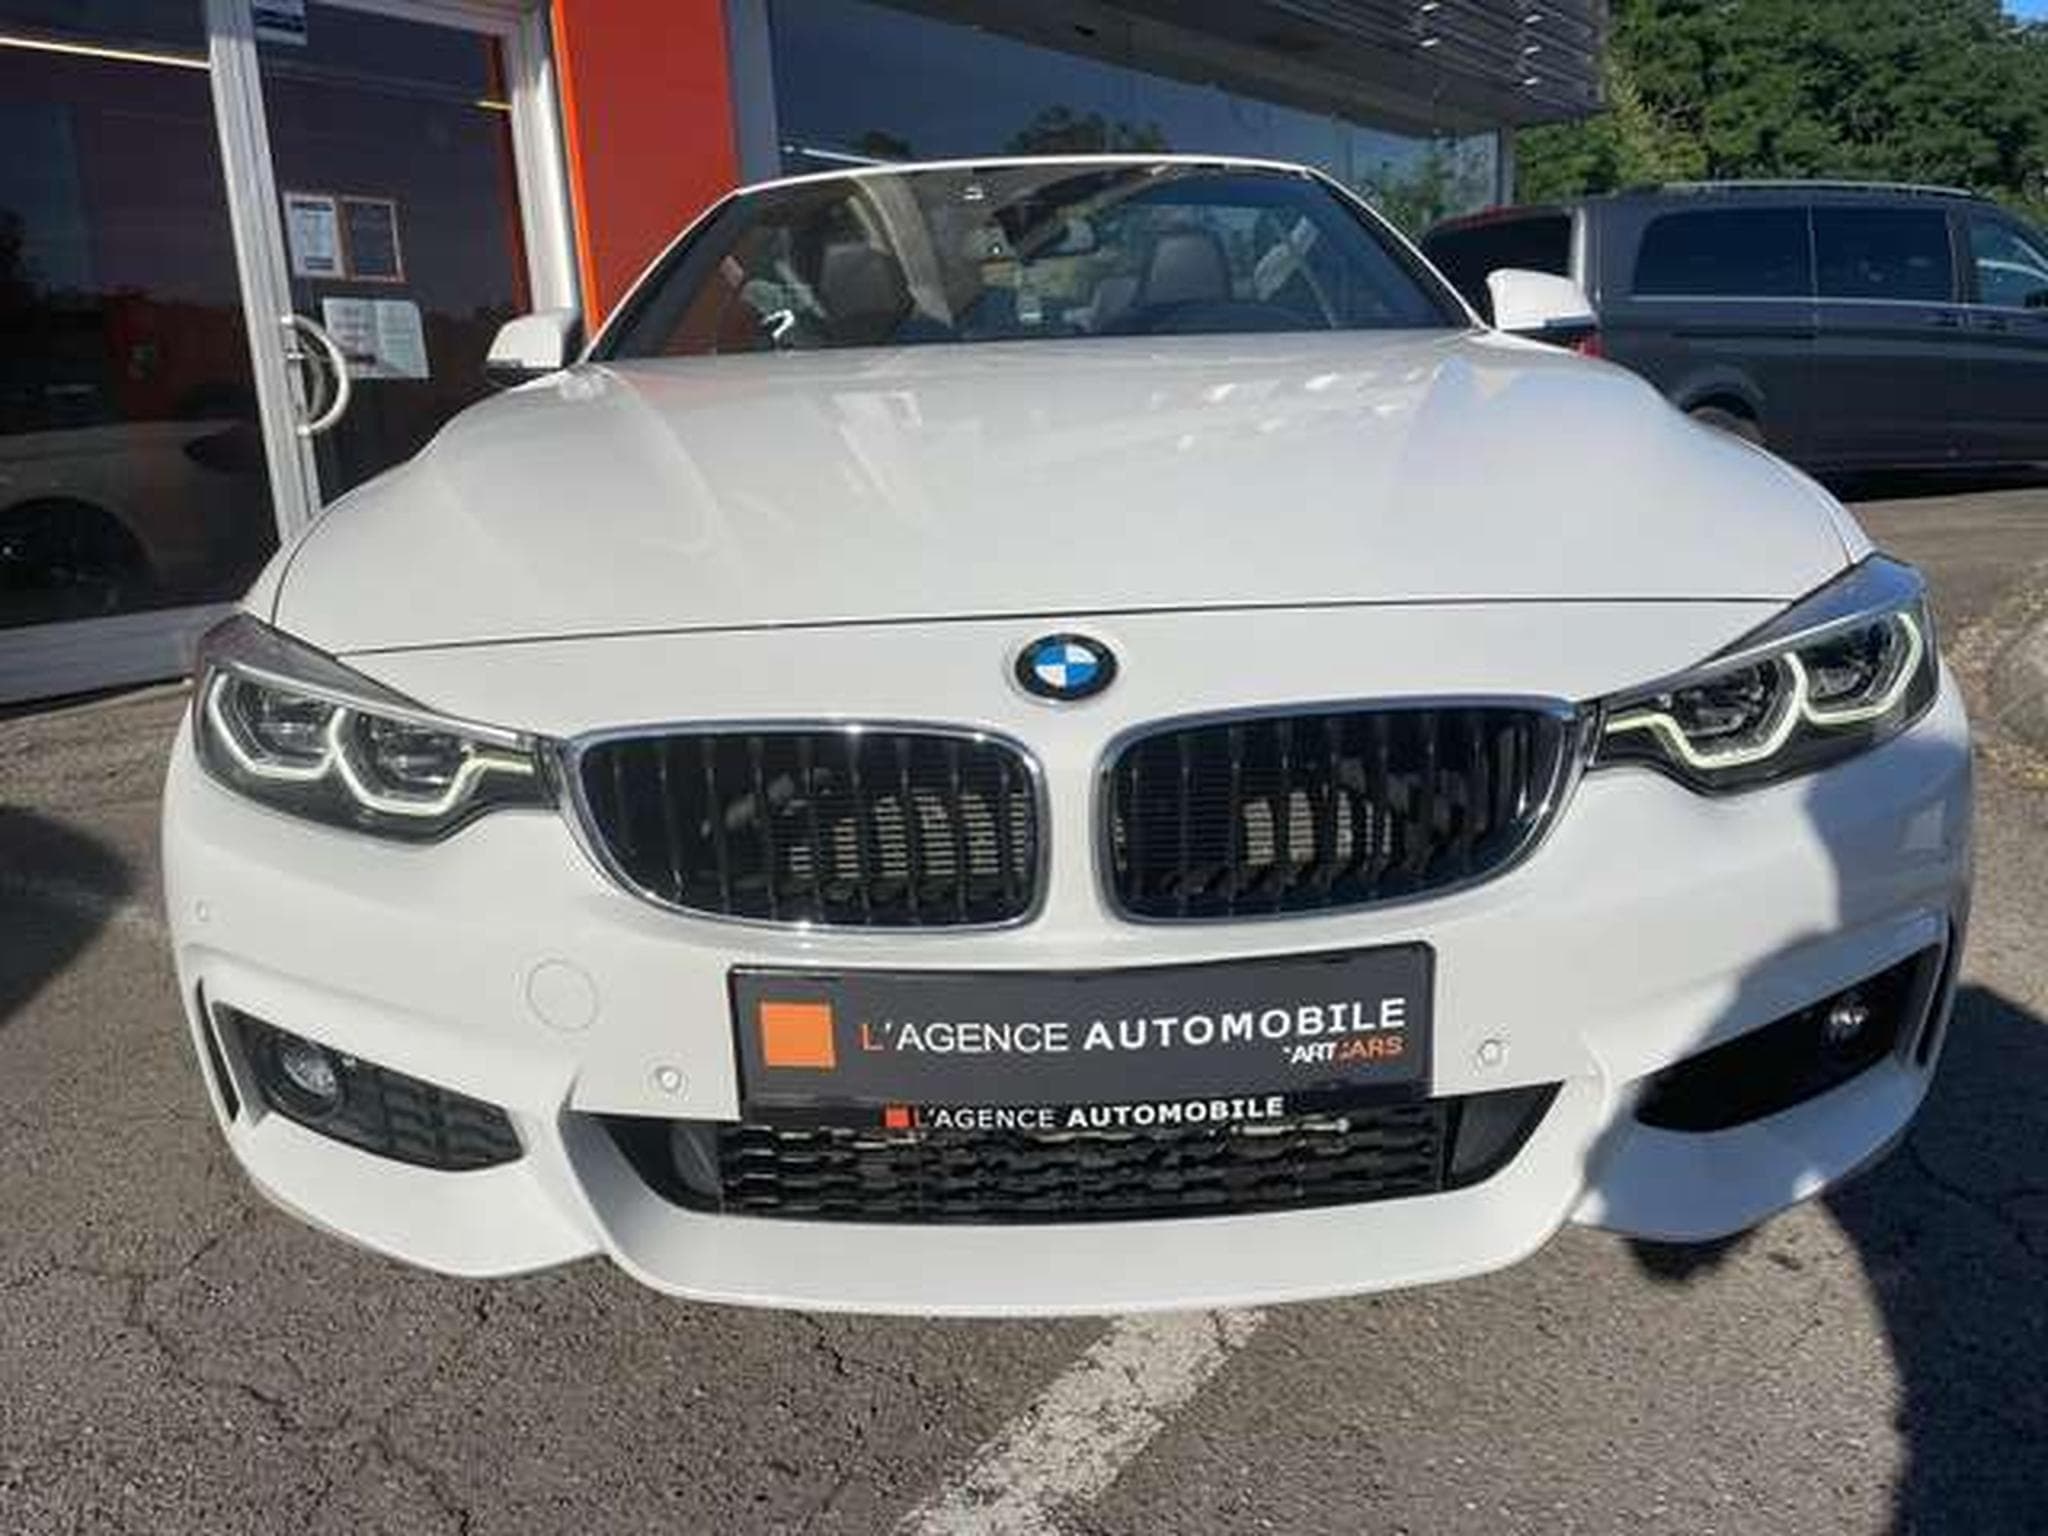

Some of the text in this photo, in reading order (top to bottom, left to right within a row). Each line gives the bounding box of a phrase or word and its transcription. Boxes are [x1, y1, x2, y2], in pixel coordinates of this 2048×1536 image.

[860, 997, 1406, 1052] L'AGENCE AUTOMOBILE
[1066, 1096, 1284, 1128] AUTOMOBILE
